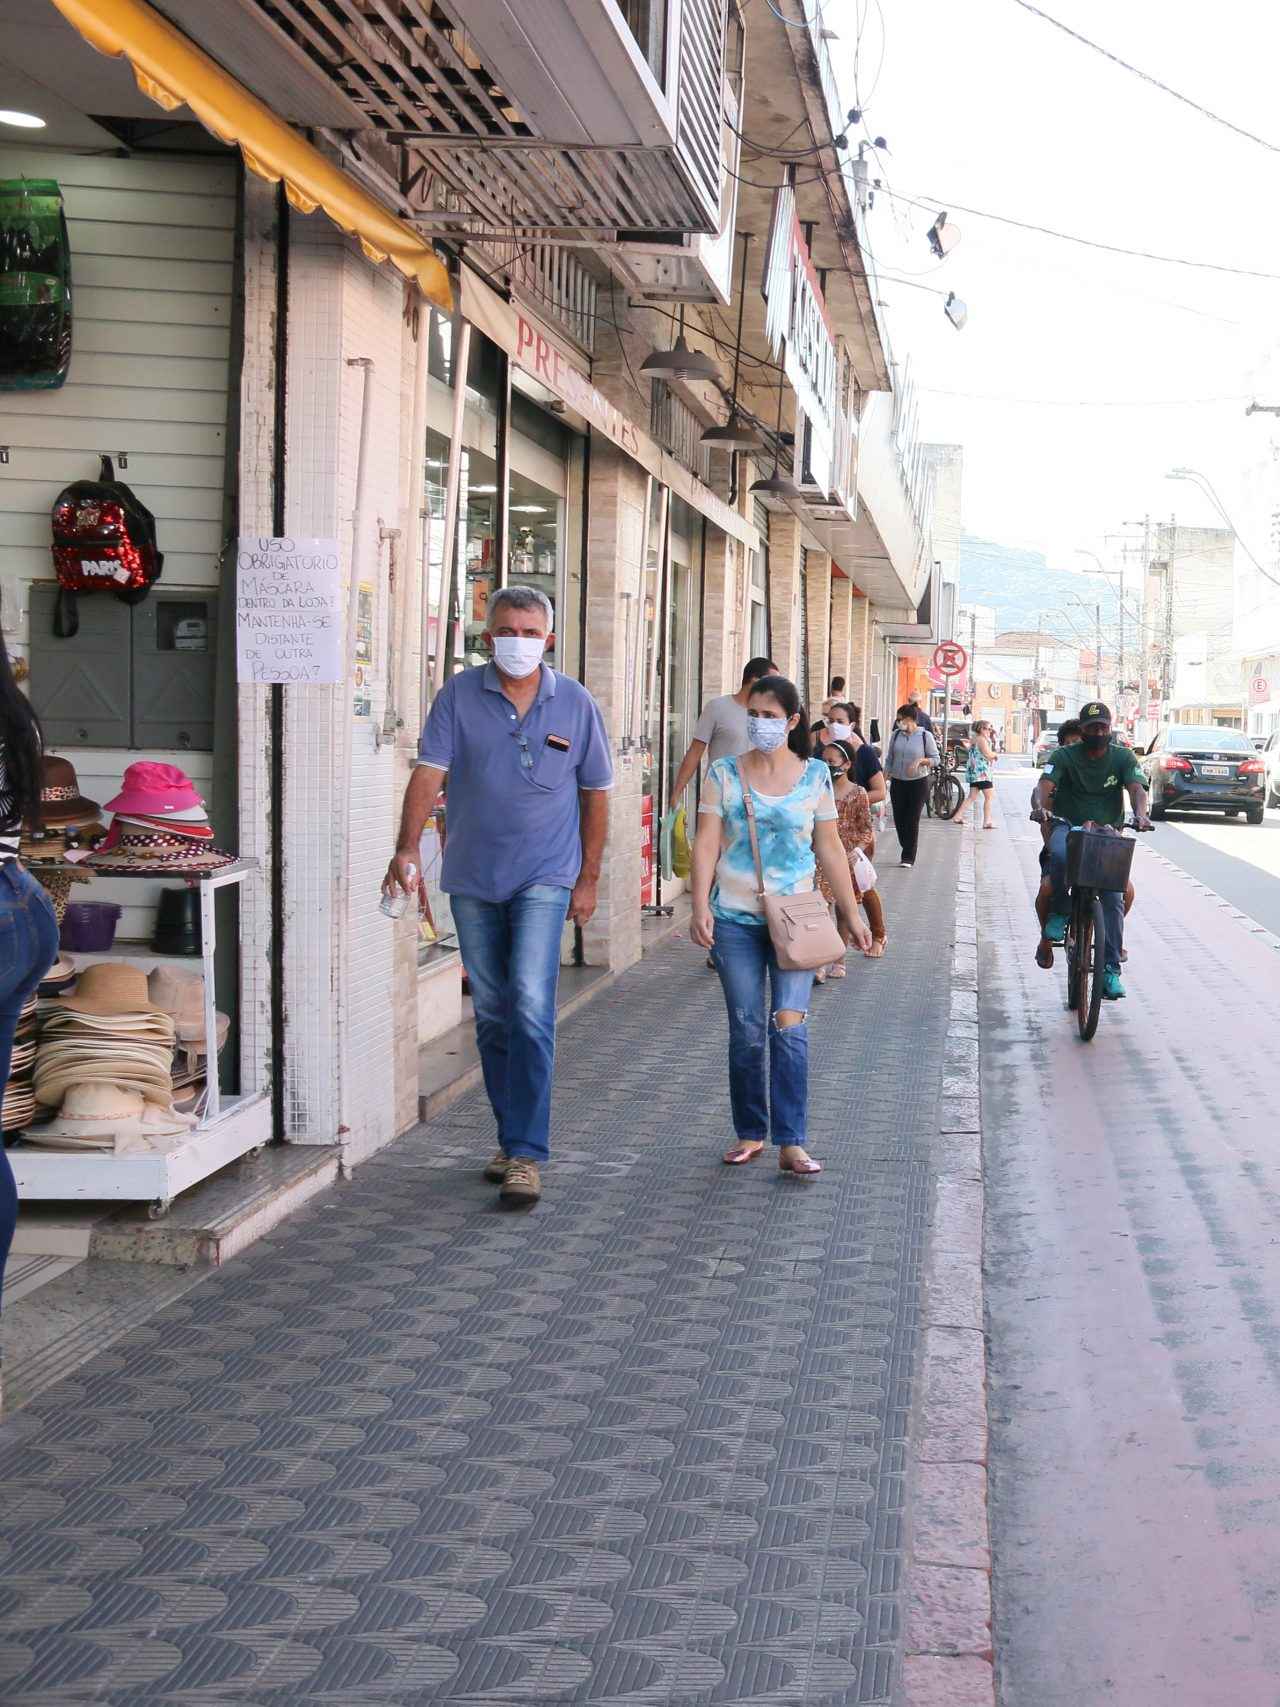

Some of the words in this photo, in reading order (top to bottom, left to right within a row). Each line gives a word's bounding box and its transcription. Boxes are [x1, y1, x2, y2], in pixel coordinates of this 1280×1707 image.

[515, 315, 642, 455] PRESNTES
[258, 538, 295, 552] USO
[272, 571, 289, 581] DE
[238, 597, 277, 609] DENTRO
[281, 598, 295, 608] DA
[238, 612, 333, 629] MANTENHA-SE
[255, 632, 314, 646] DISTANTE
[245, 648, 264, 659] DE
[275, 648, 313, 660] OUTRA
[1256, 680, 1264, 690] E
